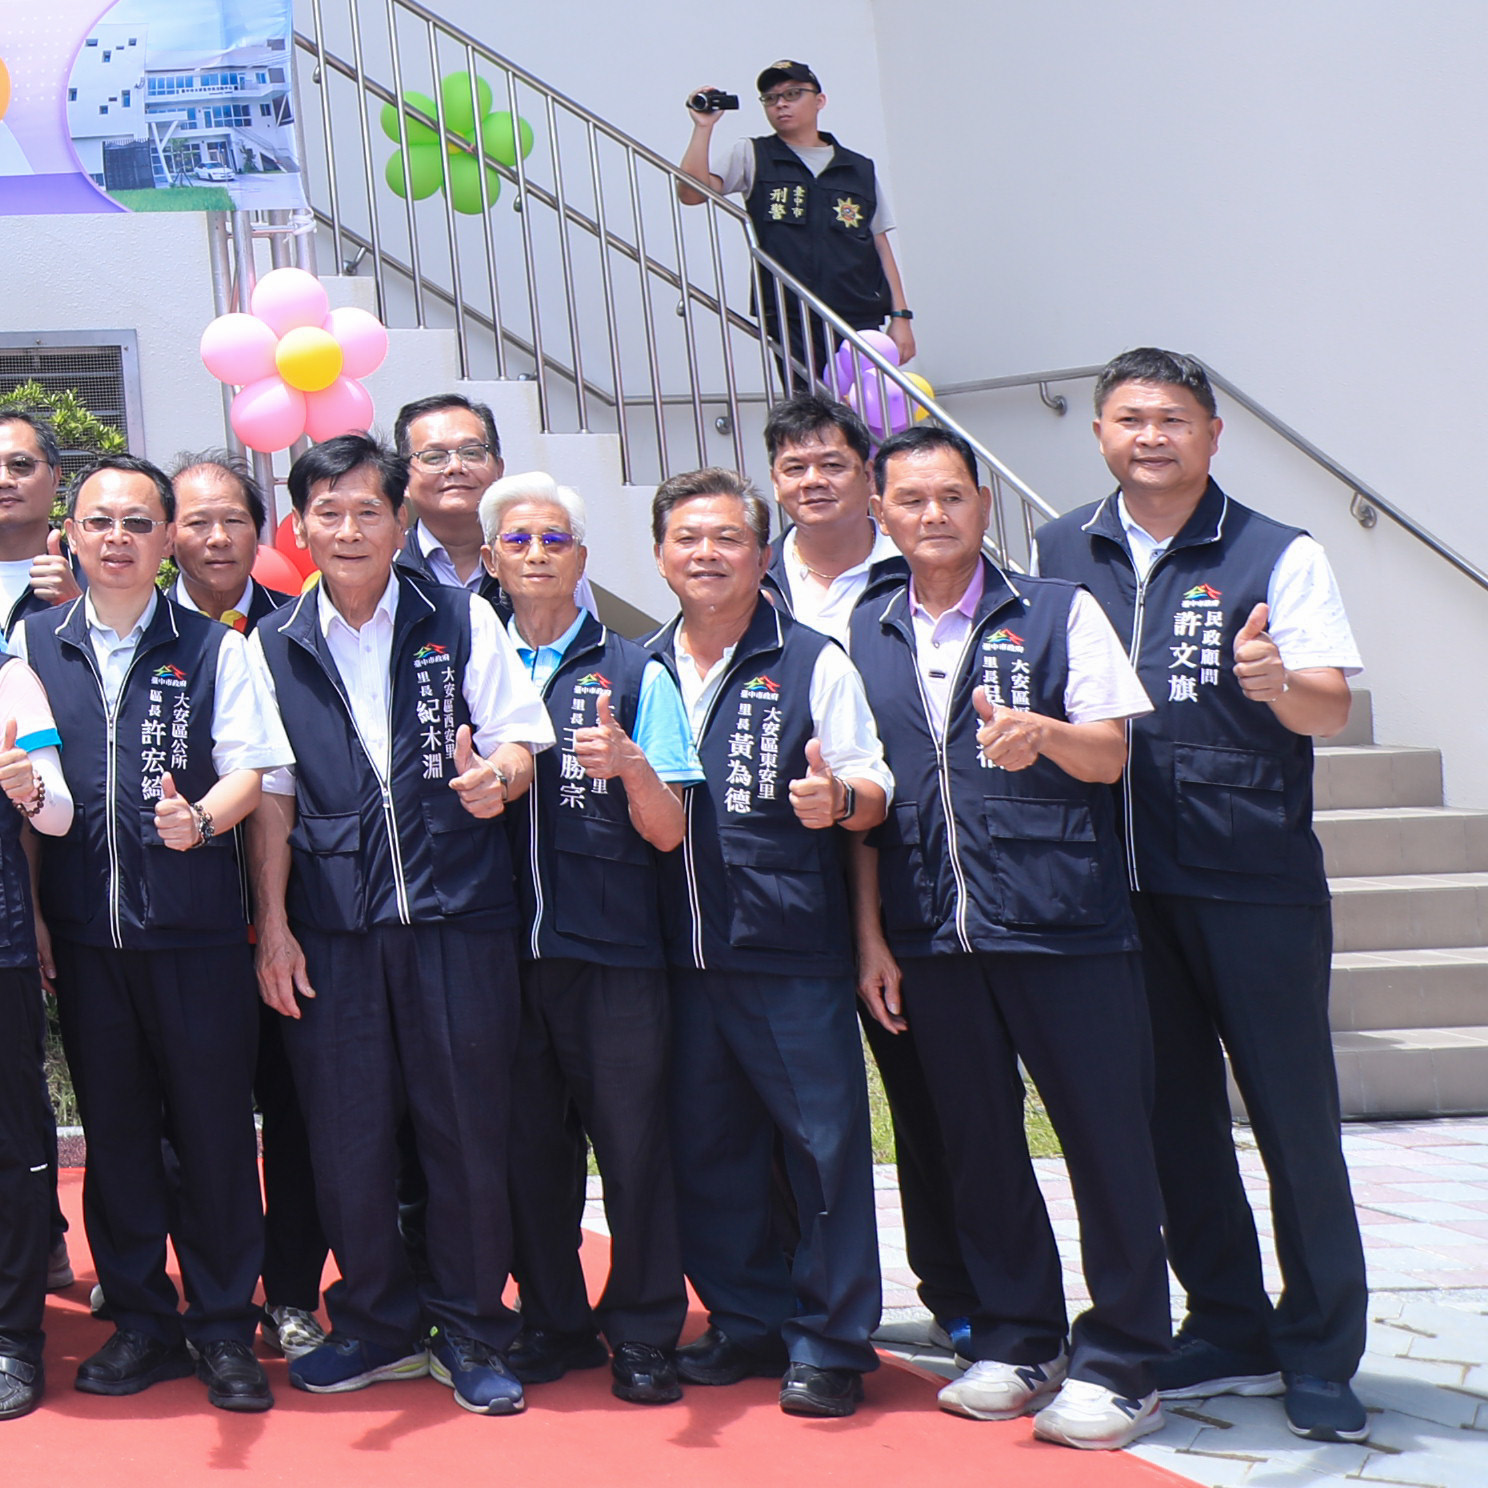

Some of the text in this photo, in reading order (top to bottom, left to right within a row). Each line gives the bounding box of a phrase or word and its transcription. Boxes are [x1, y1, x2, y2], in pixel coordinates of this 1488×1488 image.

[768, 187, 788, 219] 刑警
[1010, 658, 1031, 712] 大安區
[1167, 610, 1203, 703] 許文旗
[1200, 610, 1224, 686] 民政顧問
[148, 689, 163, 718] 區長
[170, 691, 191, 771] 大安區公所
[416, 670, 444, 780] 里長 紀木淵
[441, 665, 456, 760] 大安區西安里
[569, 697, 586, 726] 里長
[723, 702, 755, 814] 里長 黃為德
[756, 706, 783, 800] 大安區東安里
